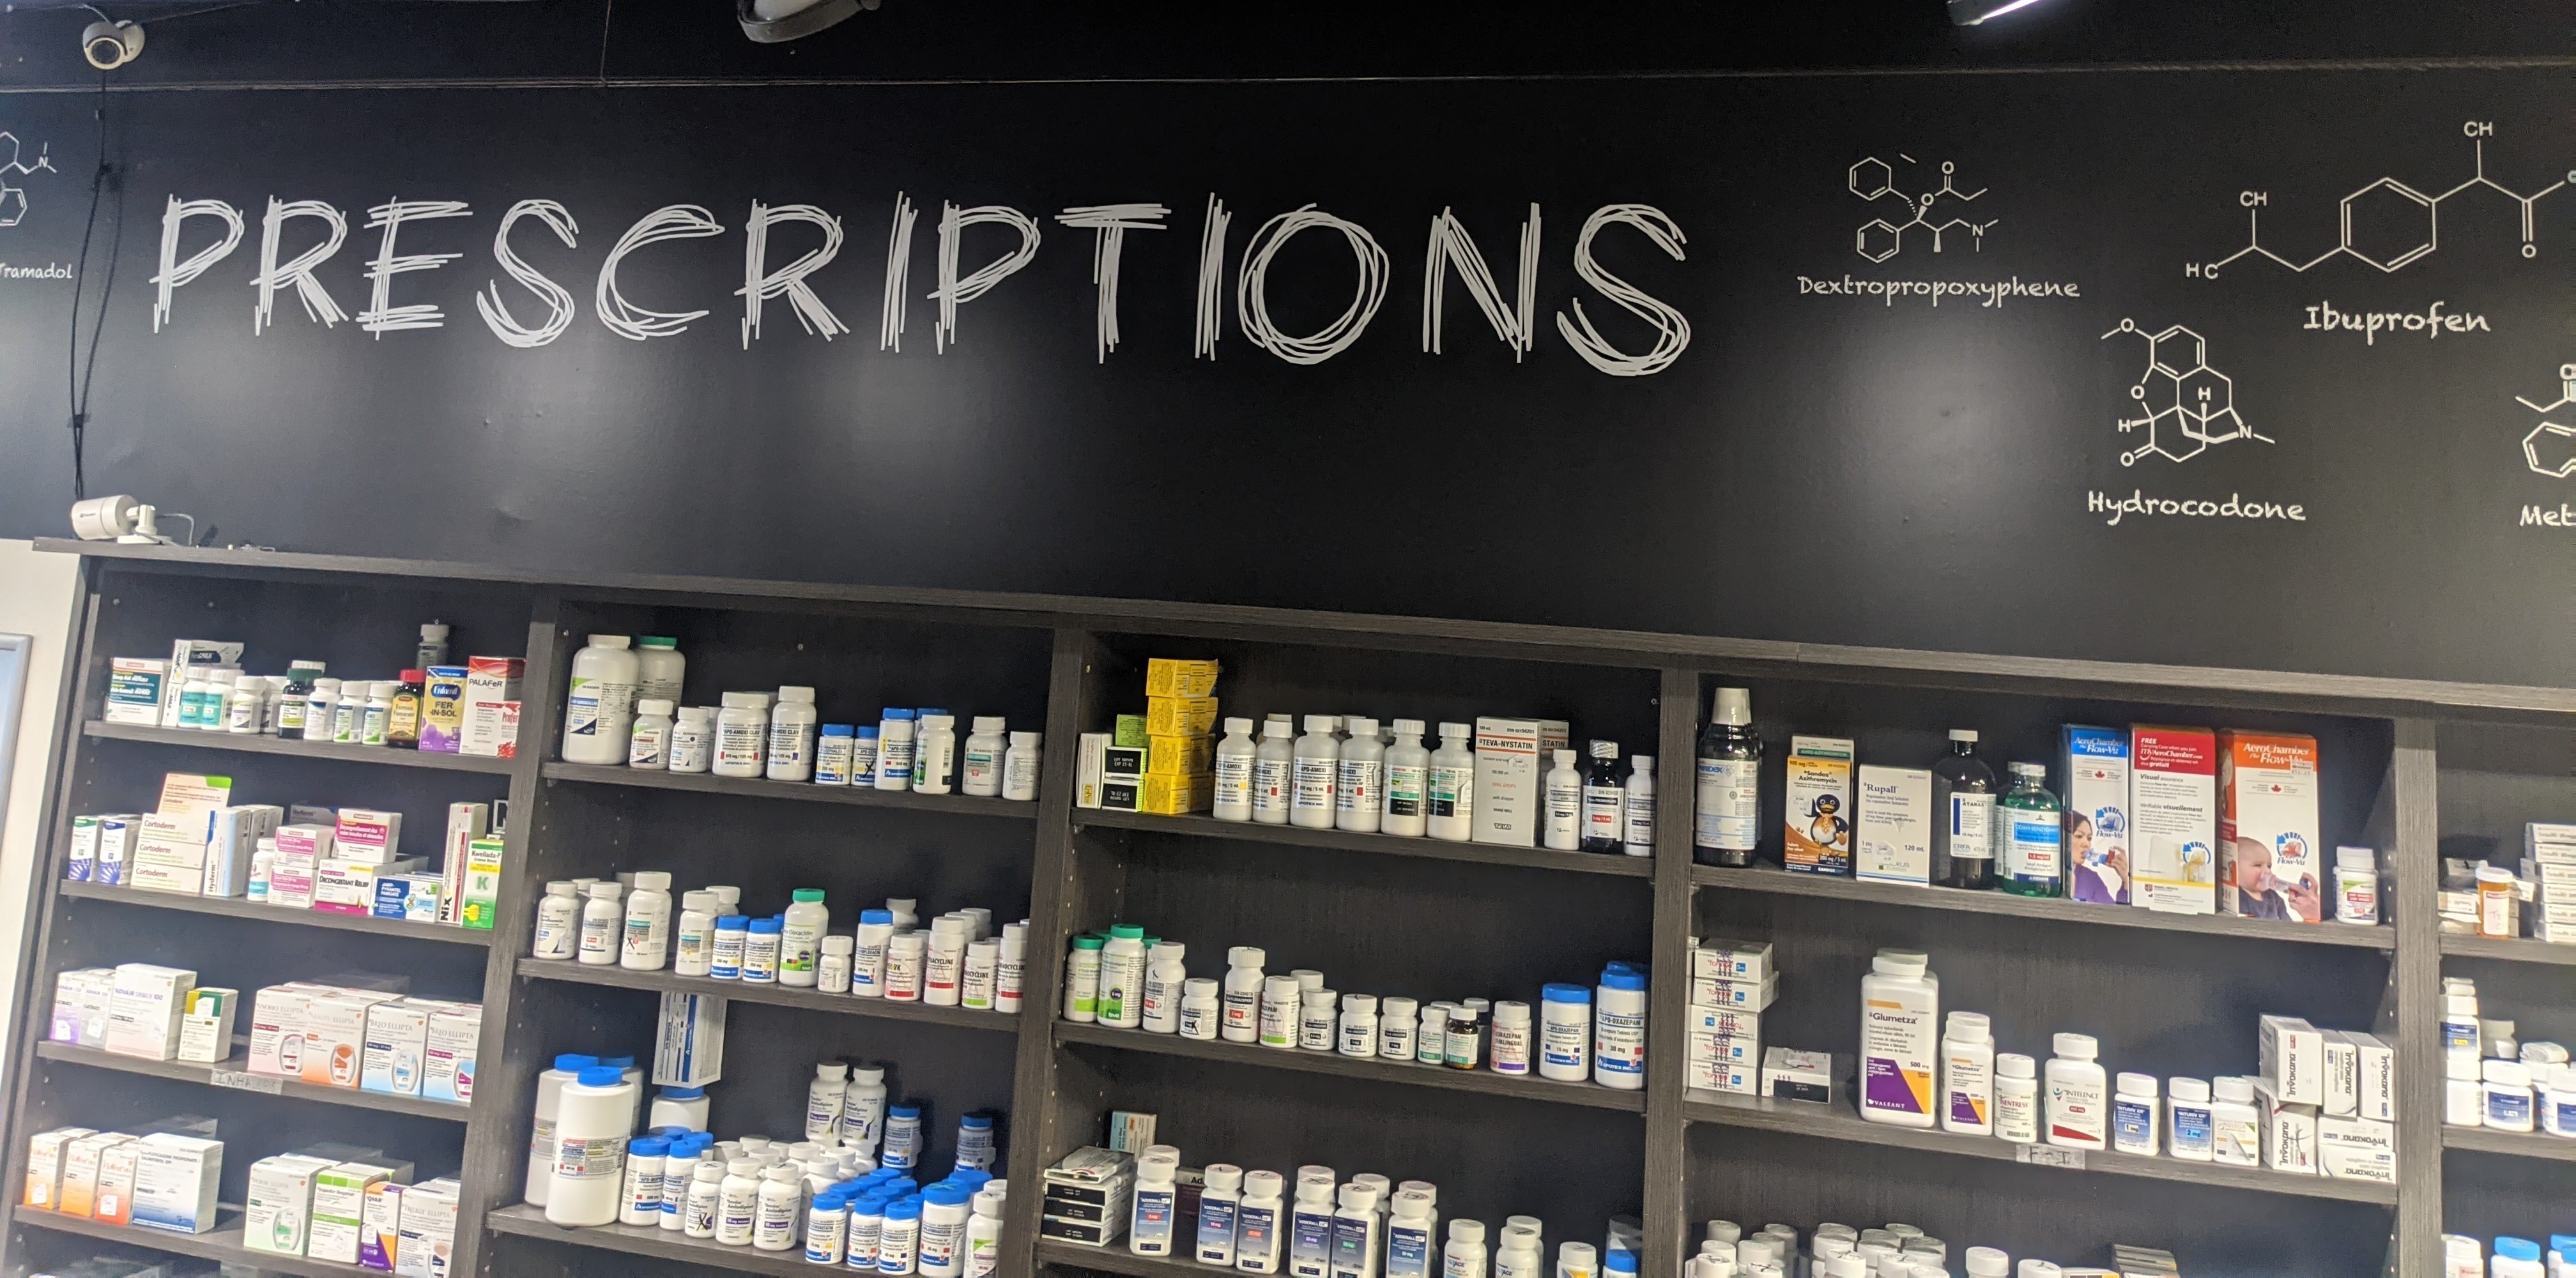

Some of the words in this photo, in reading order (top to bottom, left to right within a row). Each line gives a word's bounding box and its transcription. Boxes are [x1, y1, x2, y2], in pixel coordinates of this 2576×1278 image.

[2463, 121, 2493, 137] CH
[38, 156, 49, 167] N
[1942, 161, 1954, 175] O
[1920, 193, 1935, 206] O
[2239, 191, 2267, 207] CH
[1972, 224, 1983, 236] N
[2522, 243, 2536, 259] O
[152, 192, 1690, 378] PRESCRIPTIONS
[1797, 275, 2080, 308] Dextropropoxyphene
[2120, 318, 2135, 332] O
[2303, 301, 2491, 346] Ibuprofen
[2131, 385, 2145, 400] O
[2198, 386, 2211, 400] H
[2118, 419, 2131, 432] H
[2239, 425, 2251, 439] N
[2120, 452, 2135, 467] O
[2087, 489, 2306, 526] Hydrocodone
[1480, 738, 1533, 750] TEVA-NYSTATIN
[2087, 745, 2119, 755] Flow-Vu
[2243, 743, 2310, 756] AeroChamber
[1866, 784, 1896, 795] Rupall
[2163, 804, 2203, 813] visuellement
[144, 819, 176, 830] Cortoderm
[2096, 830, 2123, 839] Flow-Vu
[139, 844, 171, 854] Cortoderm
[2277, 856, 2305, 866] Flow-Vu
[135, 867, 168, 878] Cortoderm
[477, 876, 489, 890] K
[440, 897, 452, 921] Nix
[1602, 1016, 1641, 1026] APO-OXAZEPAM
[1873, 1012, 1916, 1024] Glumetza
[369, 1019, 386, 1029] BREO
[386, 1022, 413, 1032] ELLIPTA
[431, 1026, 447, 1037] BREO
[448, 1030, 475, 1040] ELLIPTA
[1495, 1038, 1522, 1047] SUBLINGUAL
[2287, 1054, 2296, 1096] Invokana
[2345, 1052, 2354, 1095] Invokana
[2381, 1054, 2389, 1098] Invokana
[1874, 1100, 1905, 1109] VALEANT
[2280, 1122, 2288, 1164] Invokana
[2343, 1134, 2387, 1146] Invokana
[2346, 1168, 2390, 1180] Invokana
